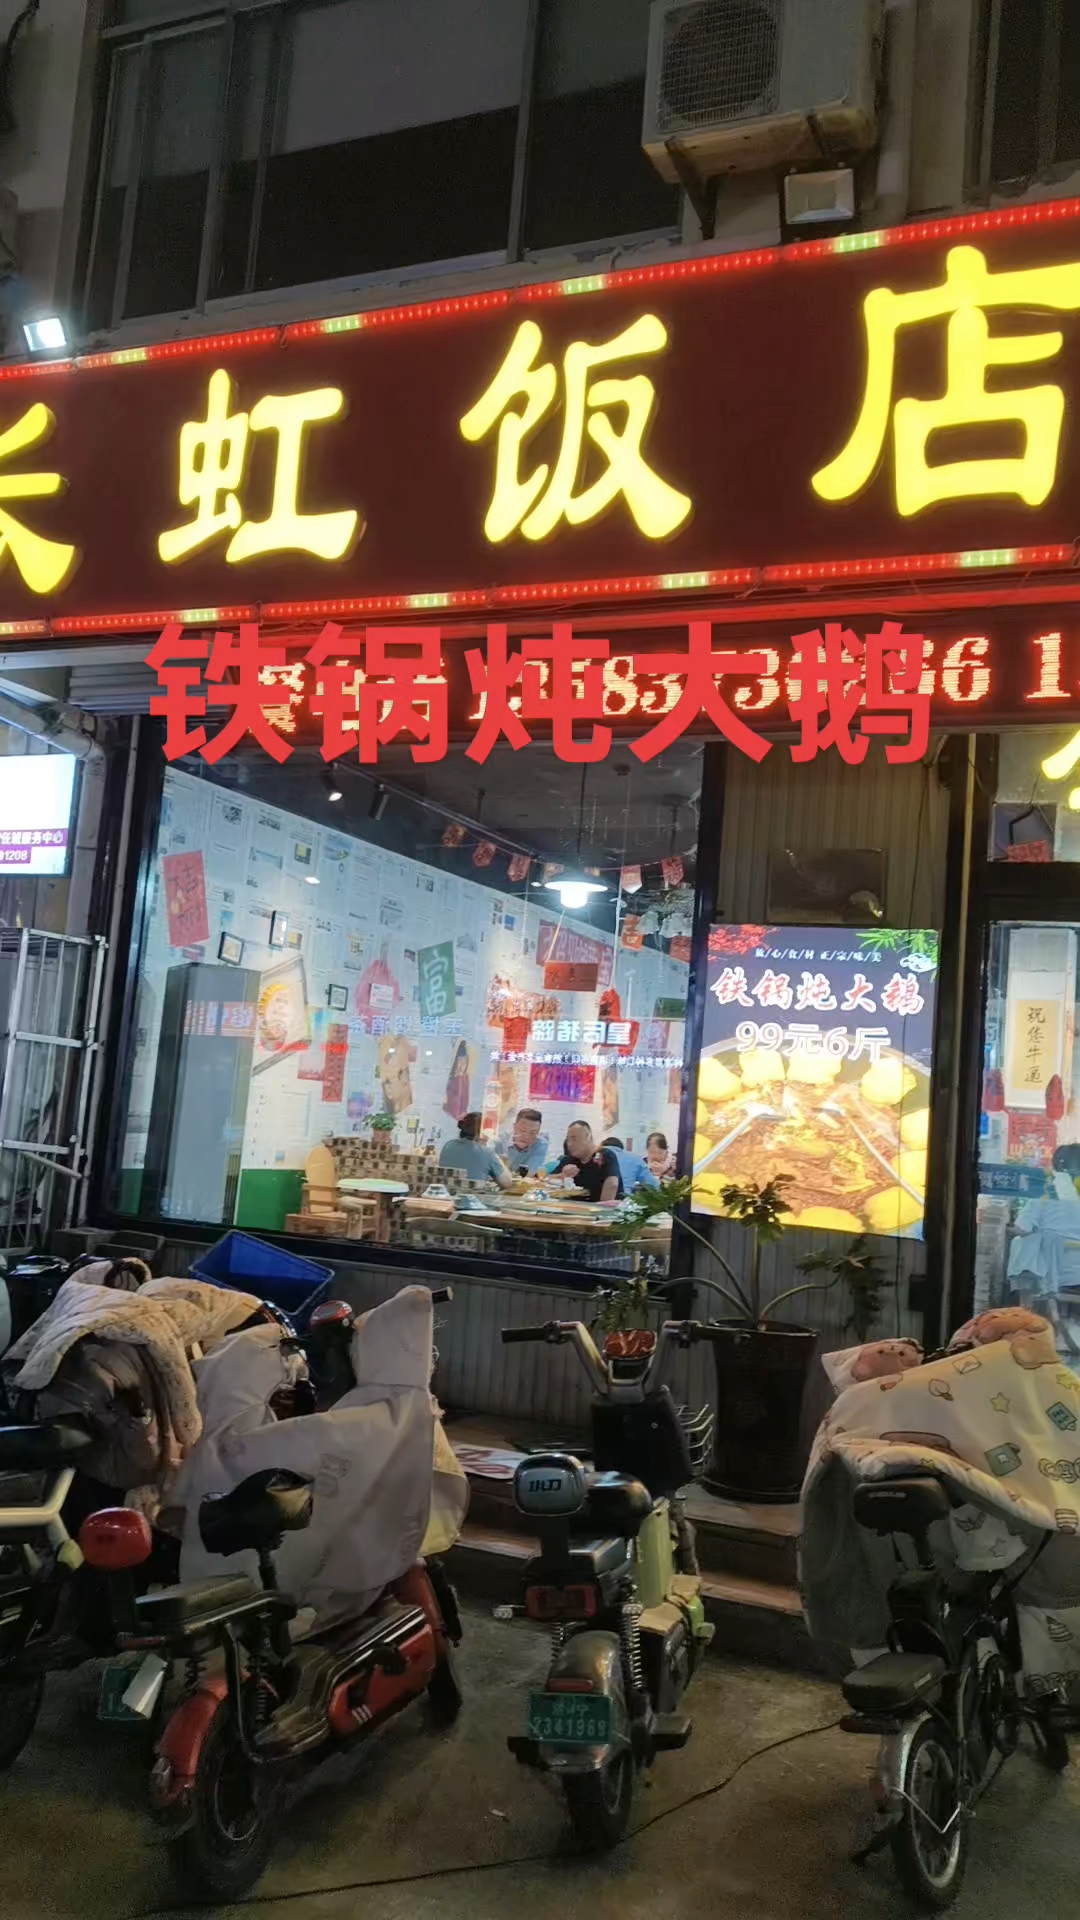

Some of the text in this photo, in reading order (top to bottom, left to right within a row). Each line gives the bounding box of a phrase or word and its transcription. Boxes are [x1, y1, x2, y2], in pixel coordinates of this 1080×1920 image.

[709, 966, 925, 1016] 铁锅炖大鹅
[735, 1021, 892, 1065] 99元6斤
